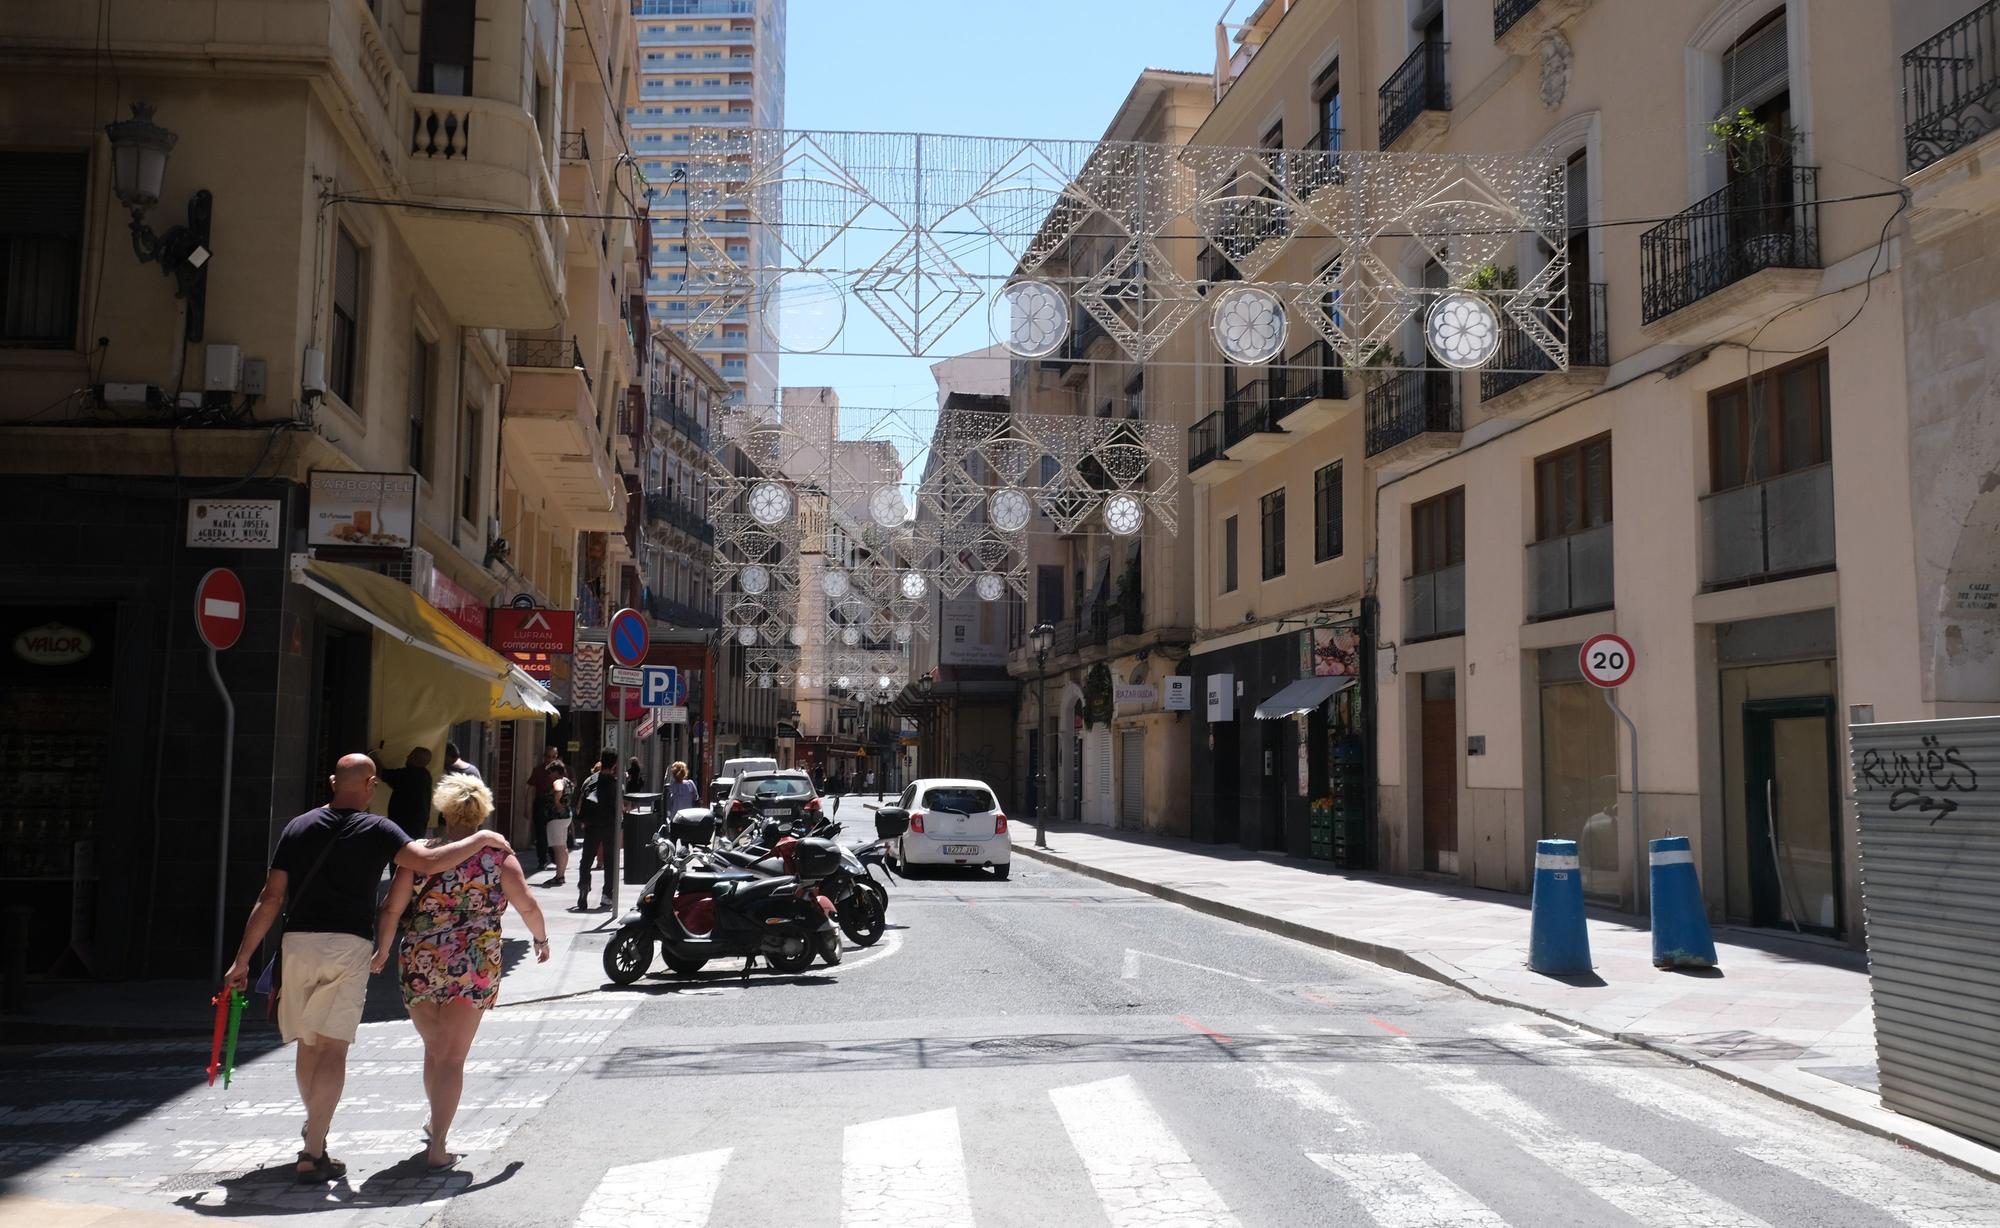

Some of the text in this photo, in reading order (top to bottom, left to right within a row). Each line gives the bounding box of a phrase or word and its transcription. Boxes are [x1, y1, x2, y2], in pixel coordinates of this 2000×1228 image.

[310, 478, 413, 492] CARBONELL
[227, 511, 262, 520] CALLE
[242, 519, 270, 528] JOSEFA
[513, 631, 553, 640] LUFRAN
[23, 636, 85, 654] VALOR
[502, 640, 564, 651] comprarcasa
[1593, 652, 1624, 669] 20
[648, 671, 670, 703] P
